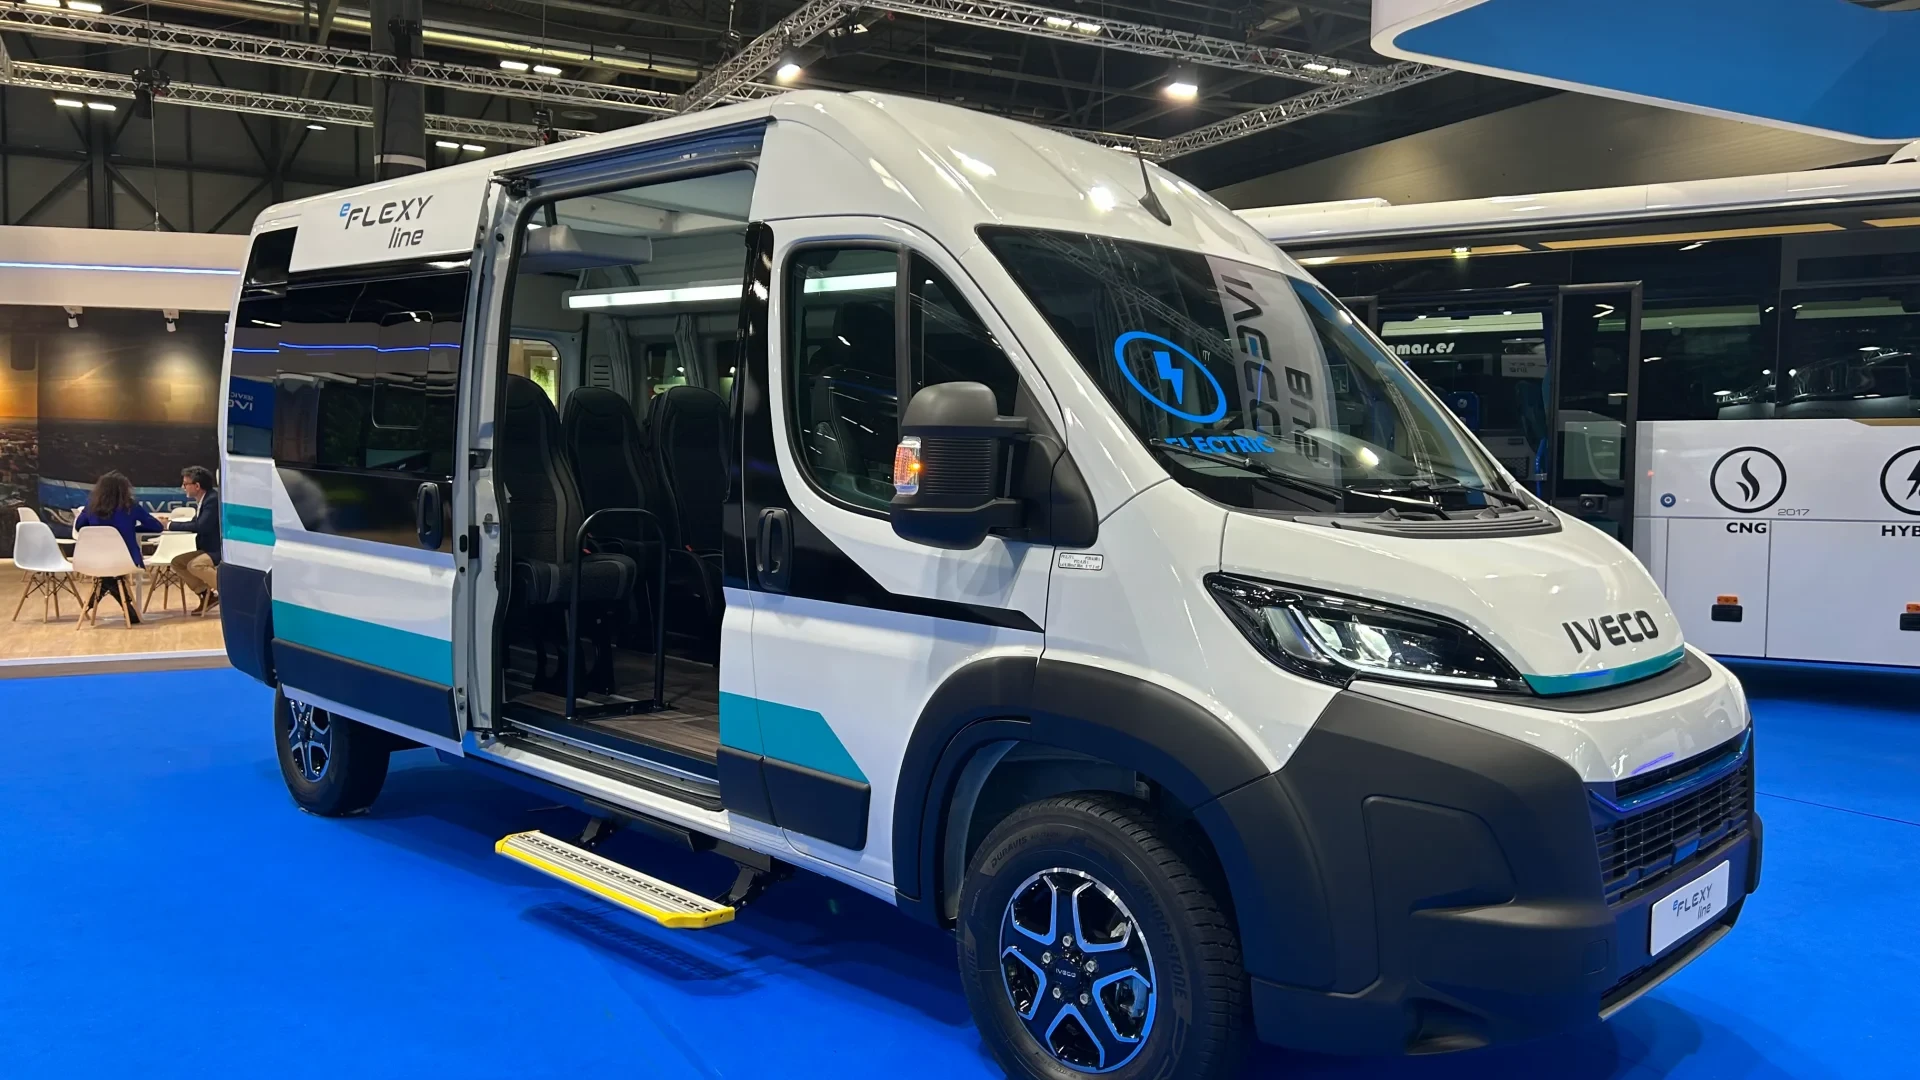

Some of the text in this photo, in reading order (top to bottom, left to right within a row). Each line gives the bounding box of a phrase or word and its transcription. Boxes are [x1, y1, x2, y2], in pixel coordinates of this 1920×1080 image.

[388, 226, 424, 249] line
[1777, 509, 1810, 517] 2017
[1726, 522, 1767, 534] CNG
[1562, 610, 1659, 654] IVECO
[1697, 902, 1712, 919] line
[1055, 967, 1077, 978] IVECO
